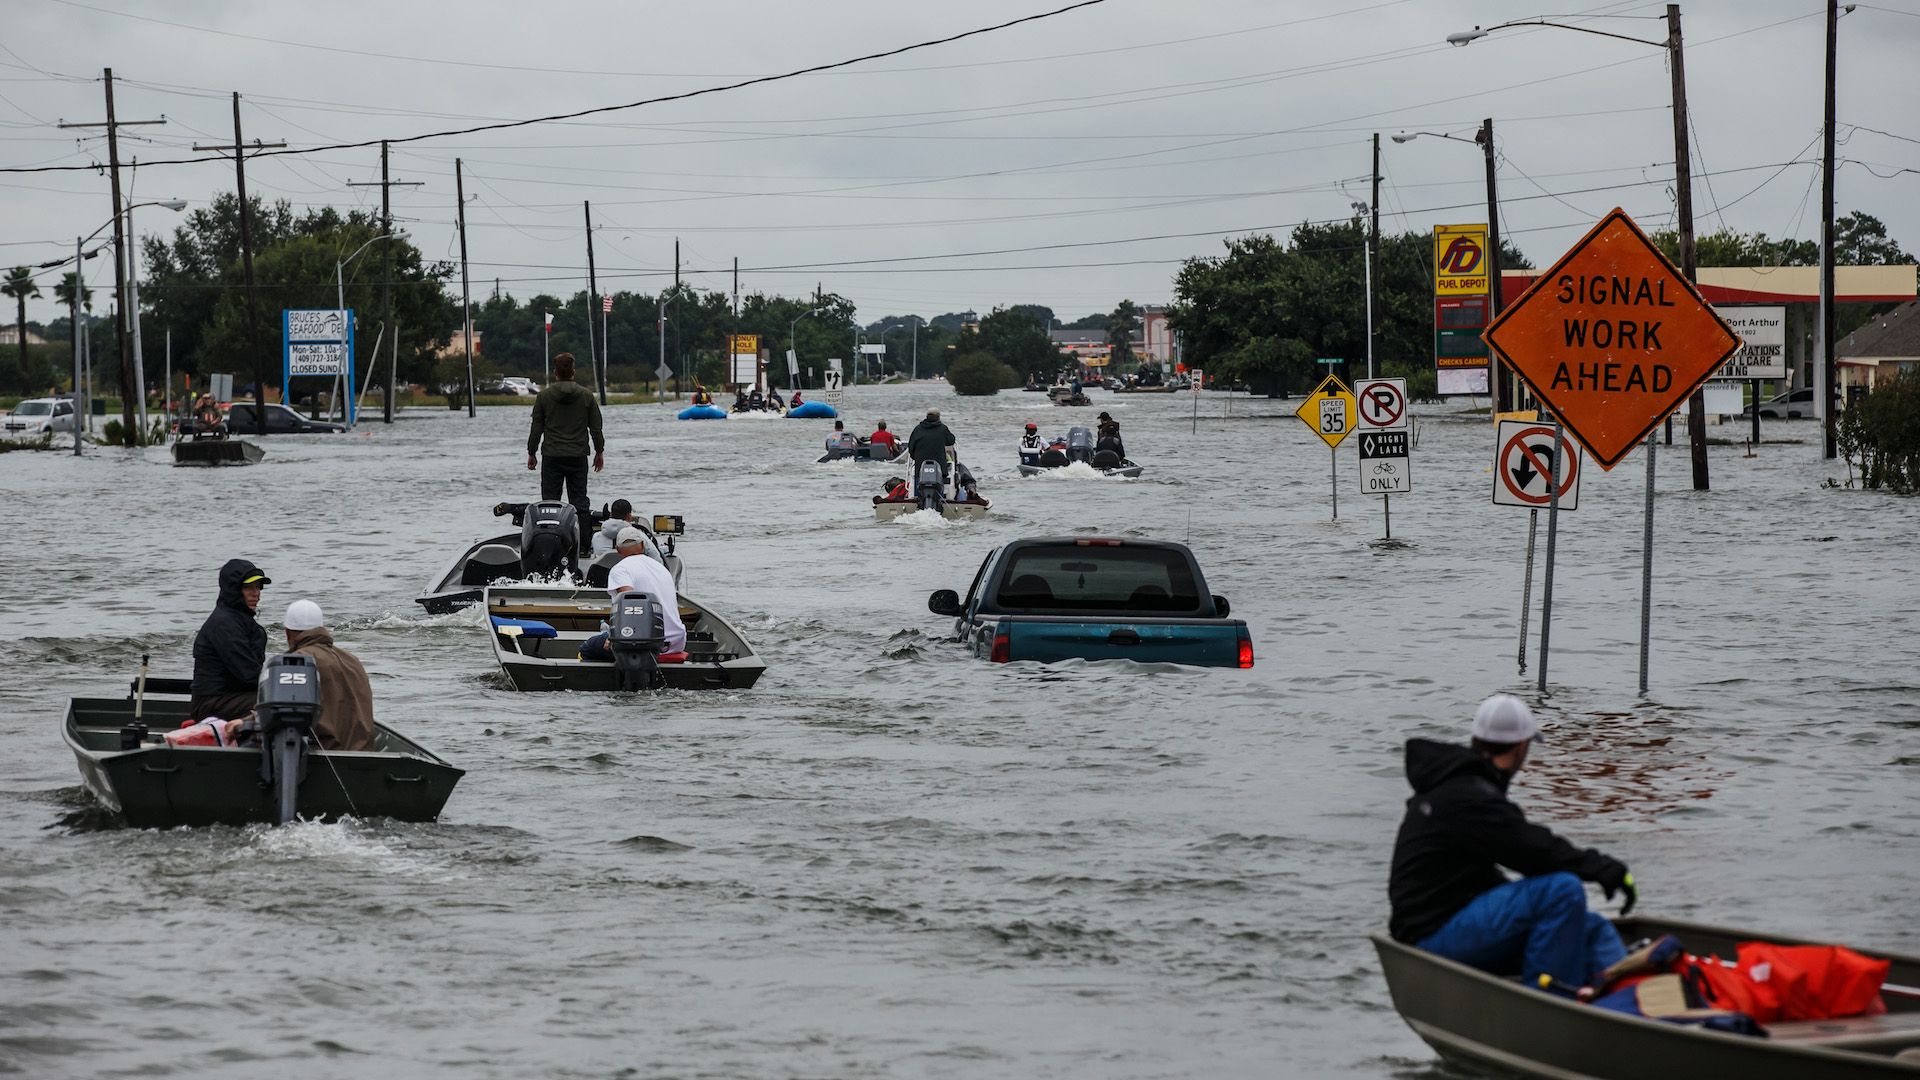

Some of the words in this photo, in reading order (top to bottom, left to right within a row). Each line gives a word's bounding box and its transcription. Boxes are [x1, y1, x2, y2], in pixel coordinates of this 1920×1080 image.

[1438, 279, 1458, 289] FUEL
[1460, 279, 1486, 288] DEPOT
[1557, 275, 1675, 307] SIGNAL
[289, 312, 320, 323] BRUCE'S
[1727, 318, 1746, 327] Port
[1748, 318, 1779, 327] Arthur
[289, 323, 324, 334] SEAFOOD
[1564, 319, 1662, 350] WORK
[1747, 356, 1772, 366] CARE
[291, 365, 318, 373] CLOSED
[1551, 362, 1673, 393] AHEAD
[1322, 413, 1344, 433] 35
[1377, 435, 1404, 444] RIGHT
[1380, 445, 1403, 454] LANE
[1370, 477, 1400, 490] ONLY
[624, 606, 644, 615] 25
[279, 672, 307, 684] 25
